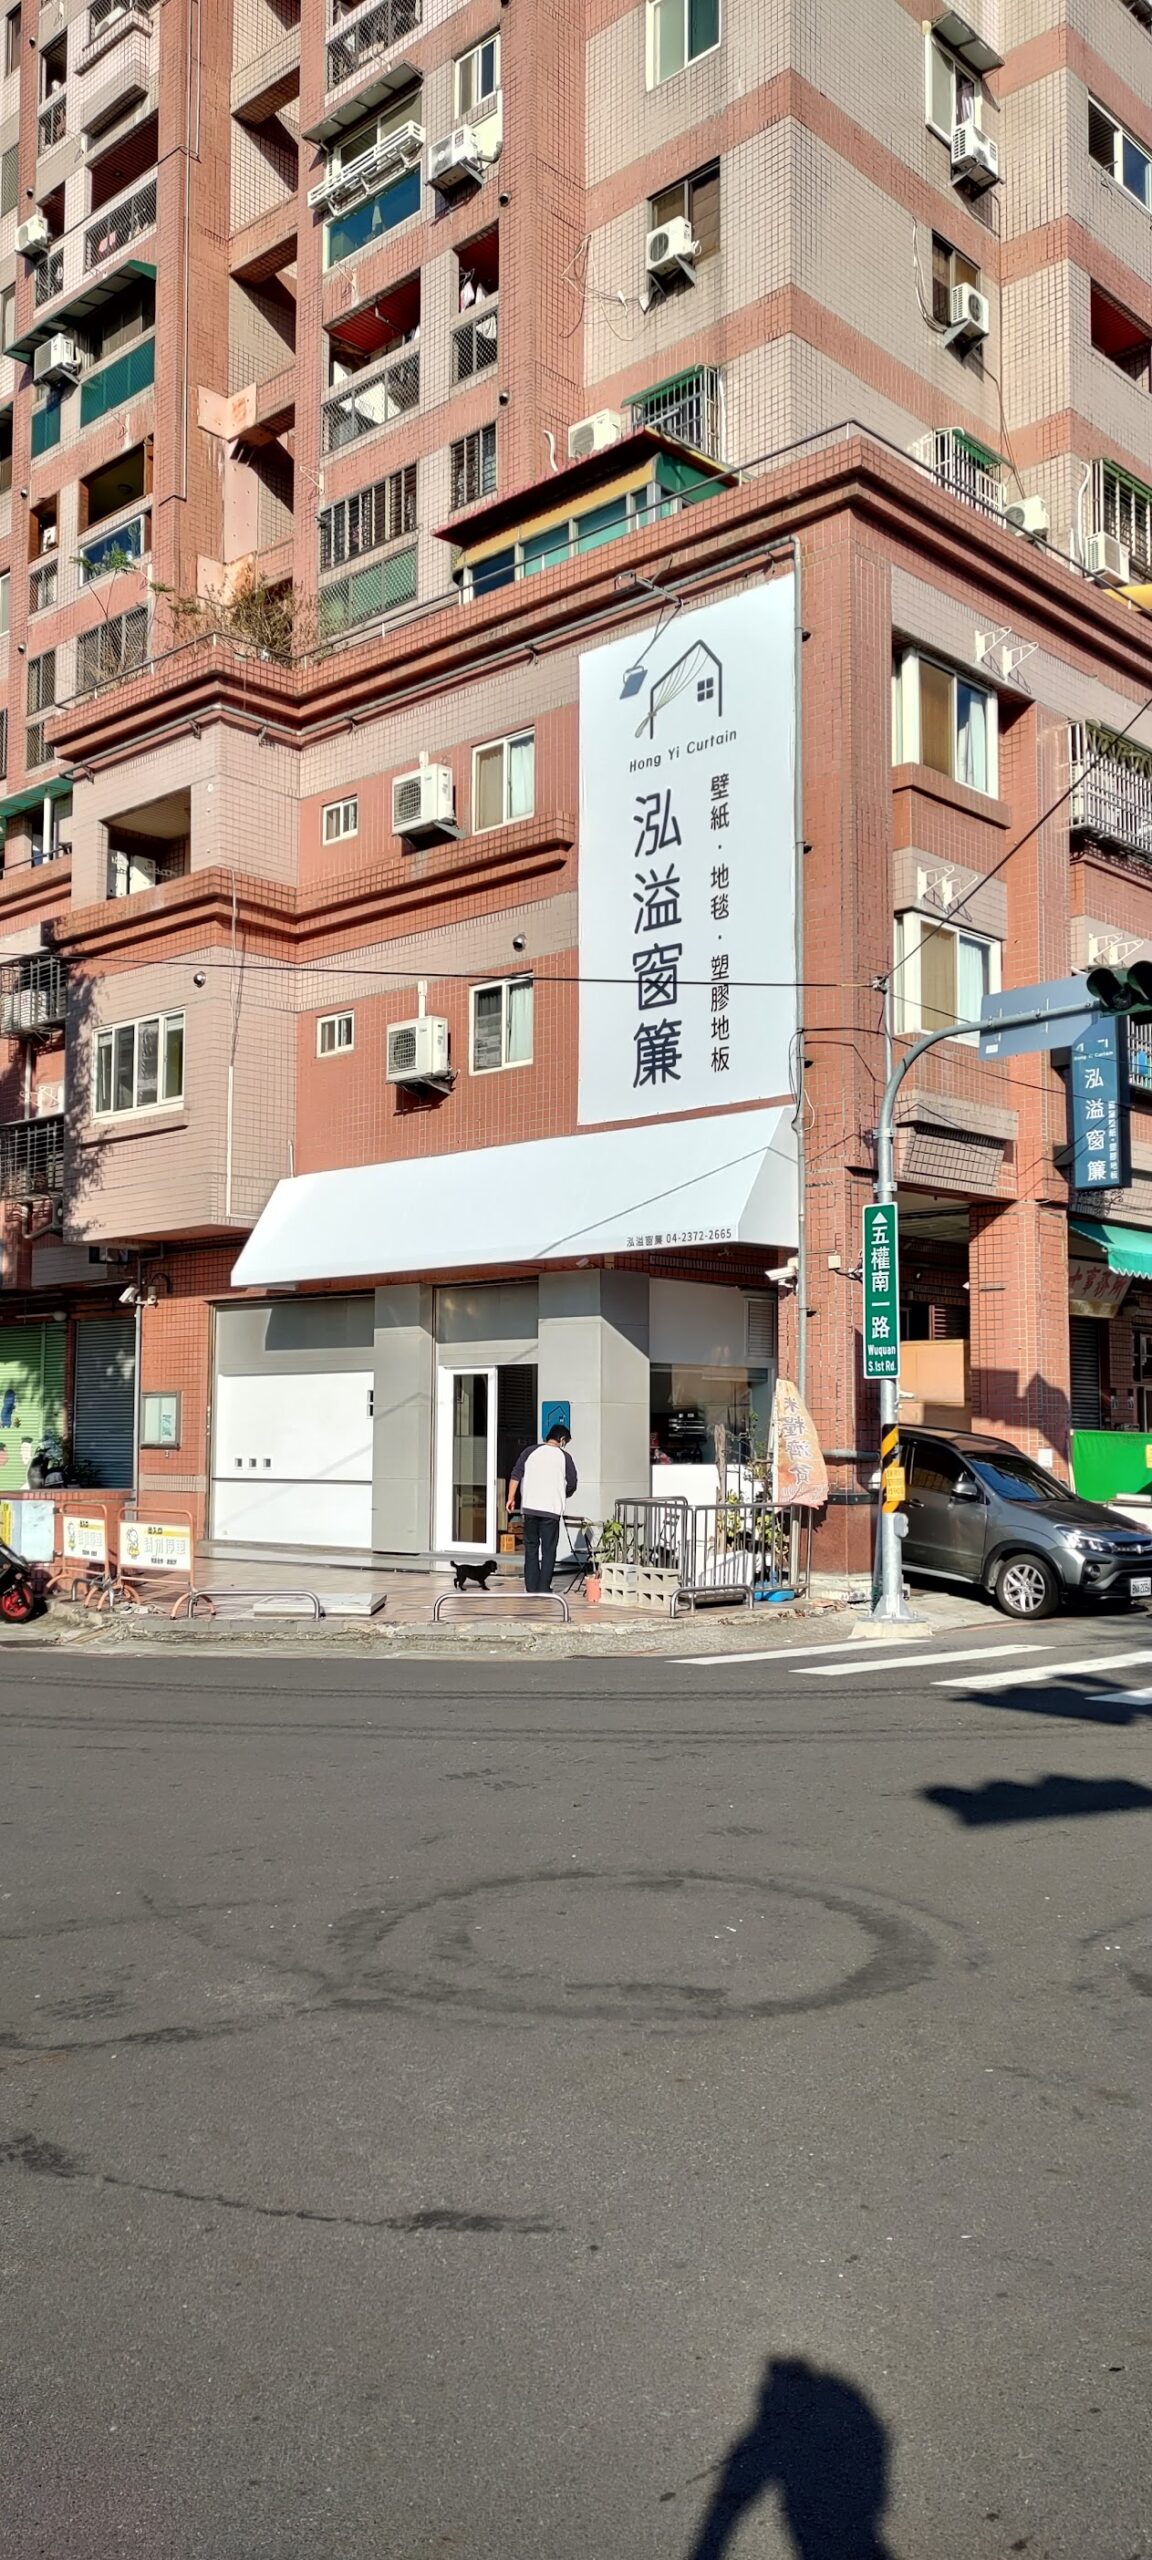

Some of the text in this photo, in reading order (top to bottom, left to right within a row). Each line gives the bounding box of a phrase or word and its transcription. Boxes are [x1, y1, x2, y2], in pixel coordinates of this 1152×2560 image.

[629, 730, 737, 773] Hong Yi Curtain
[633, 788, 682, 1088] 泓溢窗簾
[1084, 1067, 1107, 1181] 泓溢窗簾
[666, 1228, 732, 1243] 04-2372-2665
[871, 1226, 891, 1340] 五權南一路
[868, 1344, 896, 1357] Wuquan
